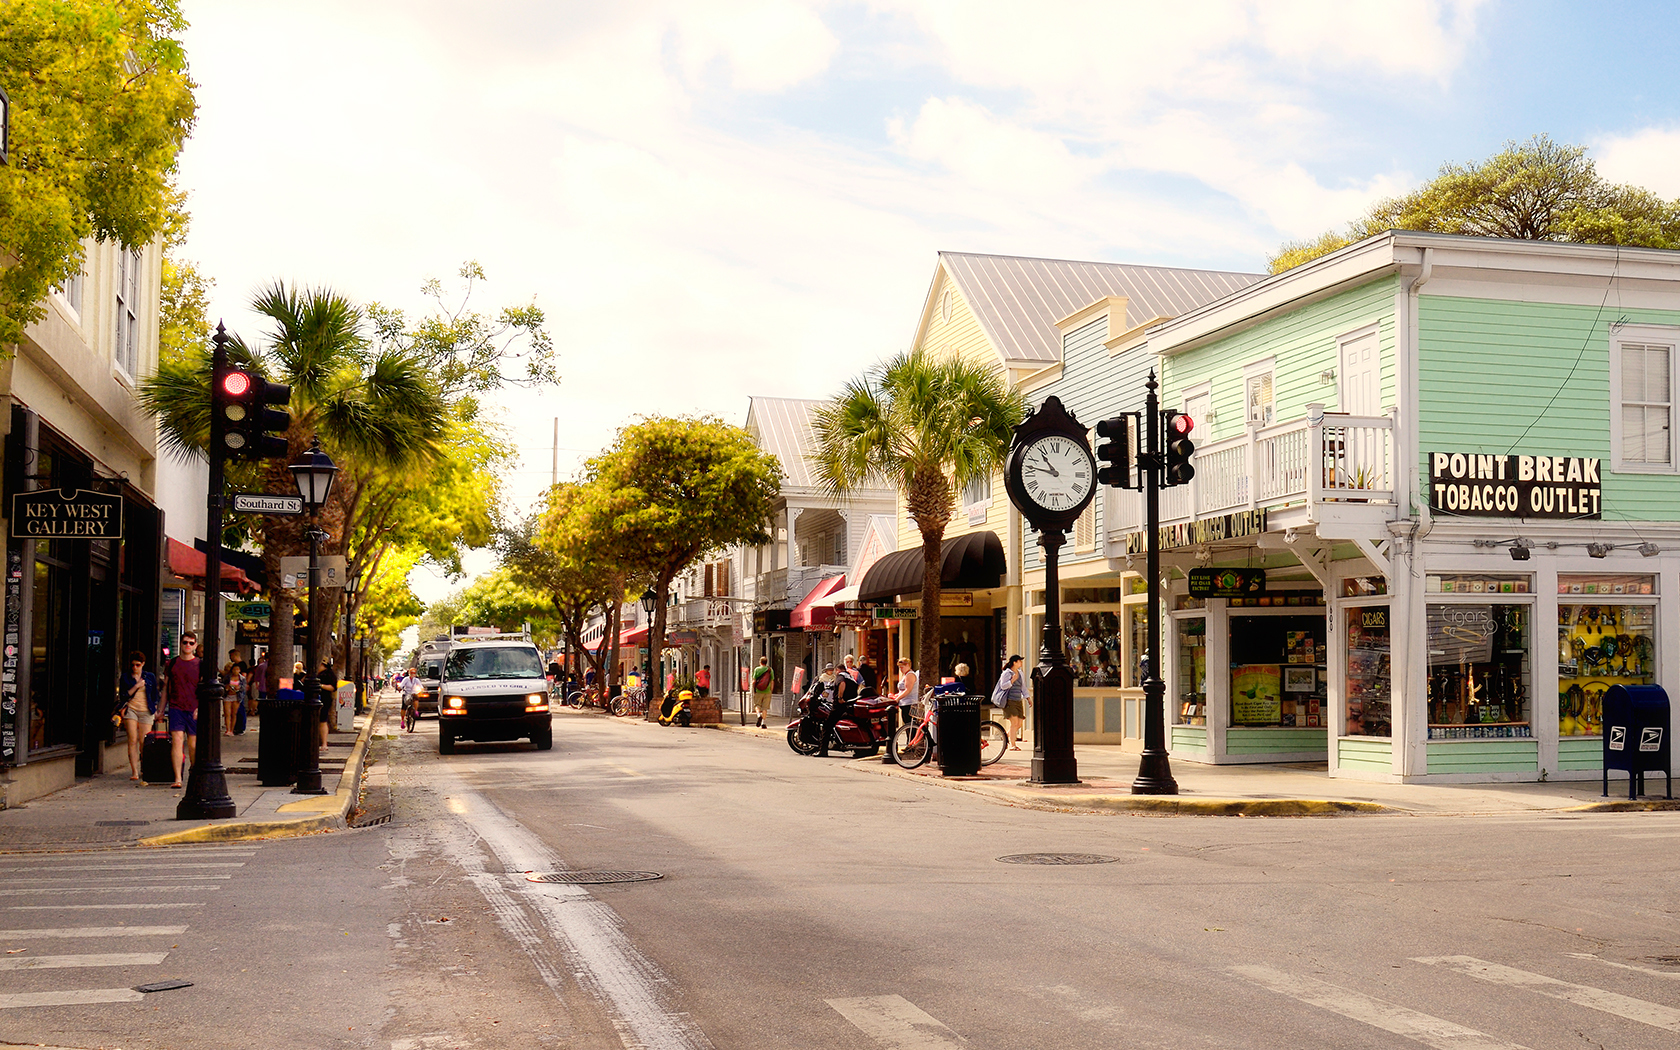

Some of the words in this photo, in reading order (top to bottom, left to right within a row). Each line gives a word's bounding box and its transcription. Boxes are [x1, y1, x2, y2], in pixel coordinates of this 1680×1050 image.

[1433, 452, 1509, 480] POINT
[1518, 455, 1600, 484] BREAK
[240, 498, 284, 510] Southard
[287, 500, 297, 510] St
[1434, 484, 1519, 512] TOBACCO
[1530, 486, 1601, 514] OUTLET
[25, 503, 61, 518] KEY
[64, 504, 113, 518] WEST
[26, 520, 109, 535] GALLERY
[1126, 531, 1148, 554] POIN
[1191, 515, 1226, 545] TOBACCO
[1230, 508, 1266, 538] OUTLET
[1362, 612, 1386, 626] CIGARS
[1442, 606, 1489, 627] Cigars
